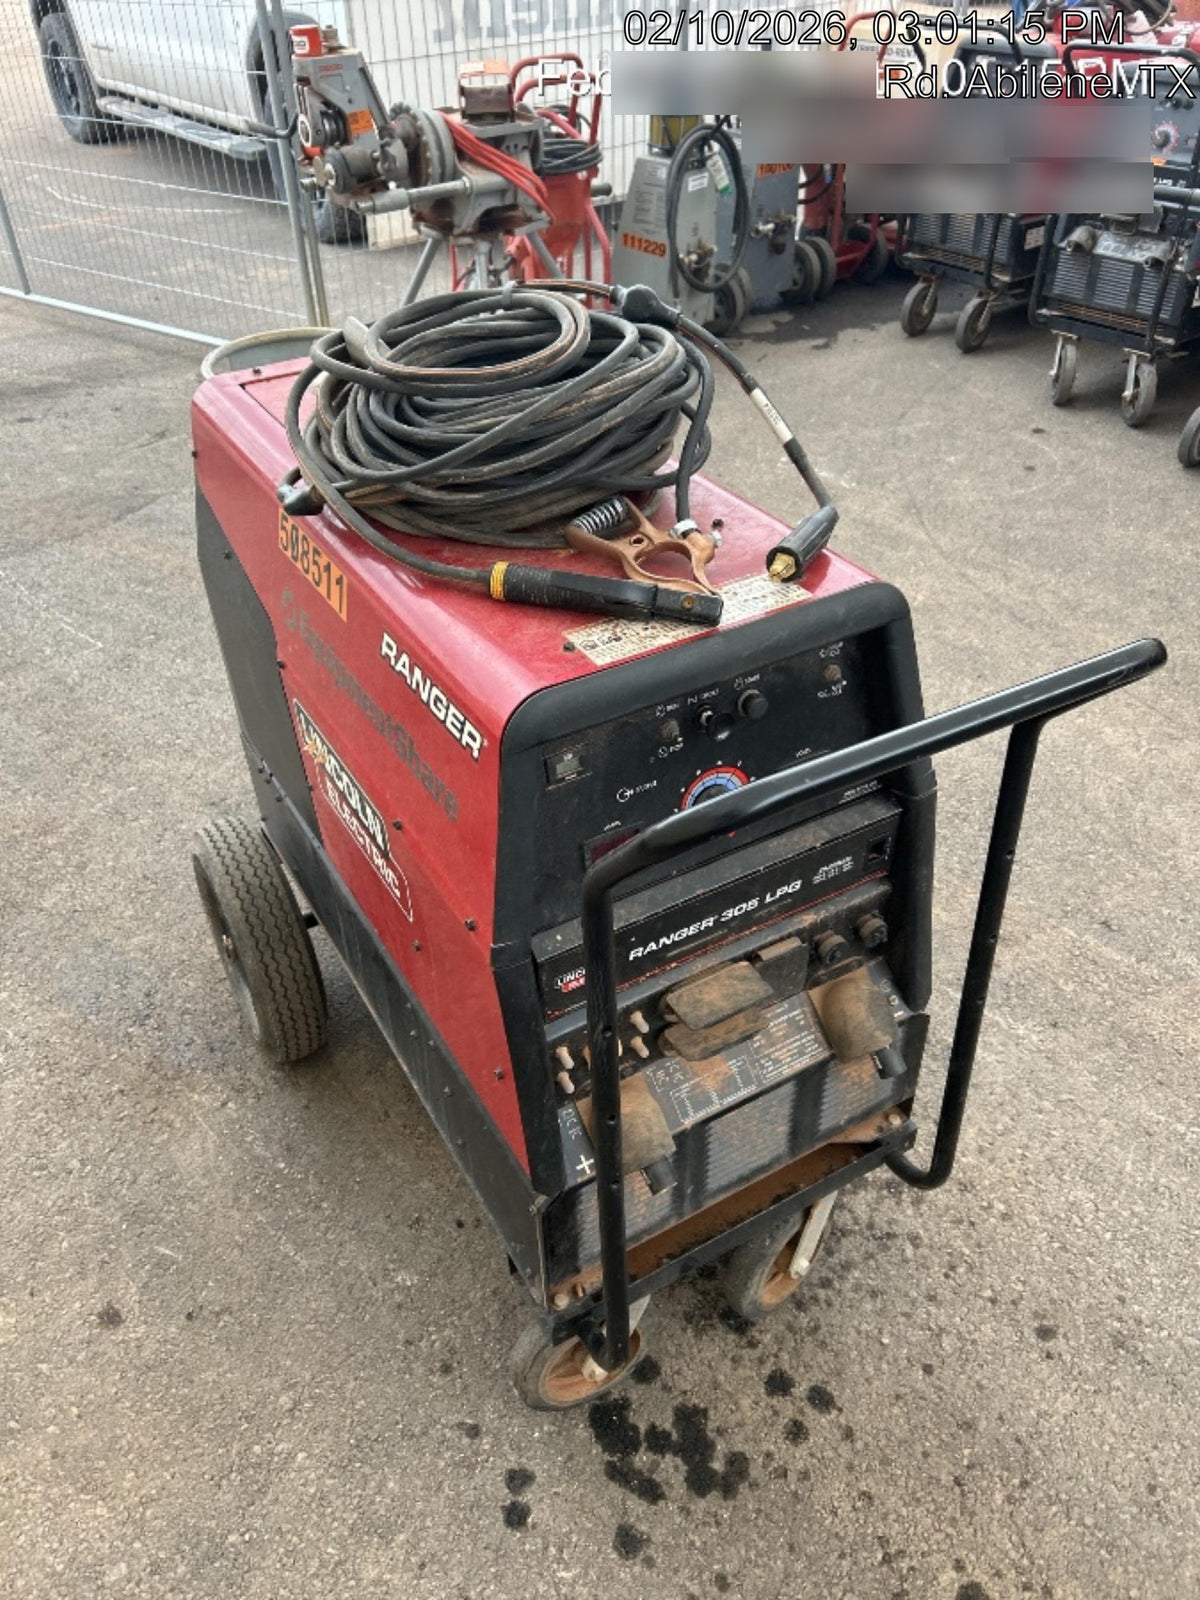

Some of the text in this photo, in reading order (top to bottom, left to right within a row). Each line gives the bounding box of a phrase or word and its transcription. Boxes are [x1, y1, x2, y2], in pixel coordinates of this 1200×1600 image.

[622, 232, 667, 257] 111229
[280, 511, 344, 614] 508511
[380, 631, 482, 761] RANGER
[298, 708, 386, 854] LINCOLN
[326, 781, 402, 900] ELECTRIC
[628, 879, 804, 962] RANGER 305 LPG
